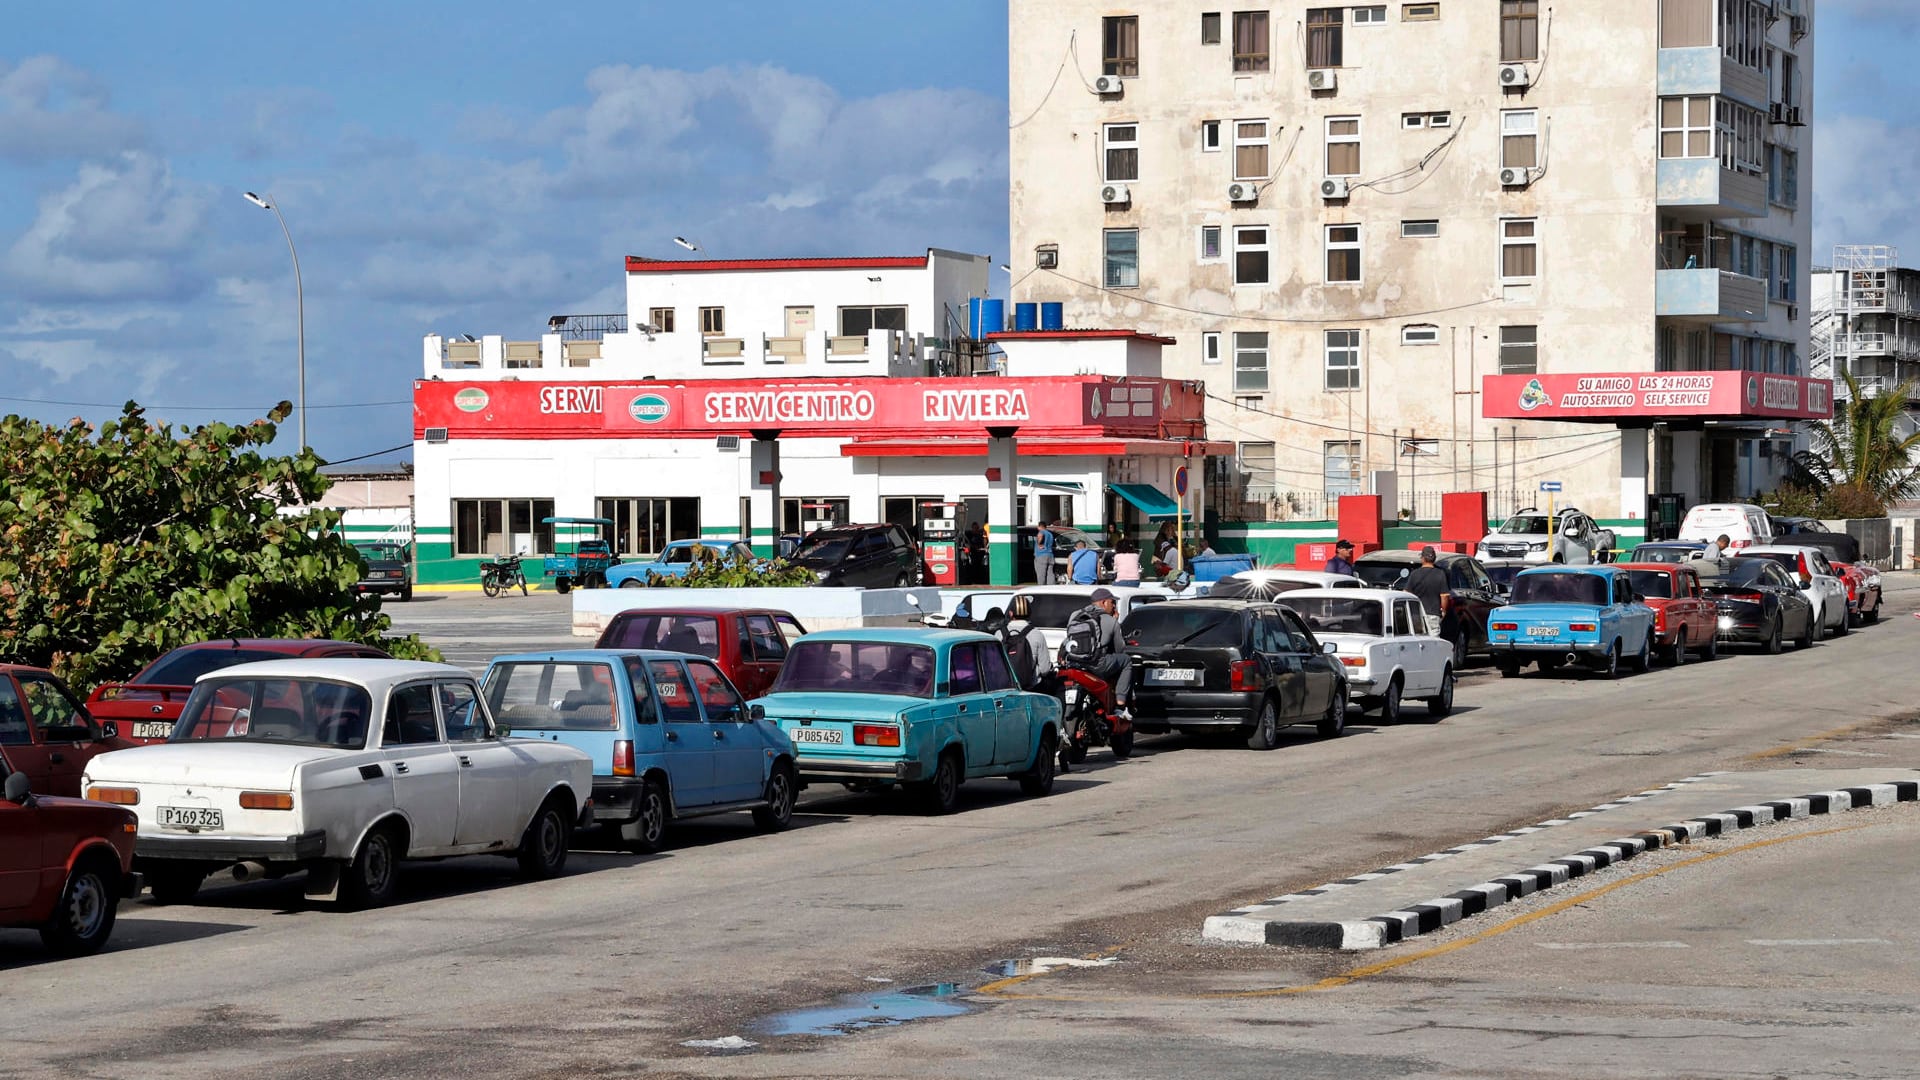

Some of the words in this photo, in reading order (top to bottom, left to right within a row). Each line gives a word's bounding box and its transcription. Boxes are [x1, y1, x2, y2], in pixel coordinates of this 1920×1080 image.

[1579, 379, 1591, 390] SU
[1595, 379, 1631, 390] AMIGO
[1640, 378, 1657, 389] LAS
[1660, 378, 1673, 389] 24
[1676, 377, 1711, 388] HORAS
[1646, 394, 1666, 405] SELF
[1669, 393, 1708, 404] SERVICE
[705, 394, 873, 420] SERVICENTRO
[922, 393, 1027, 420] RIVIERA
